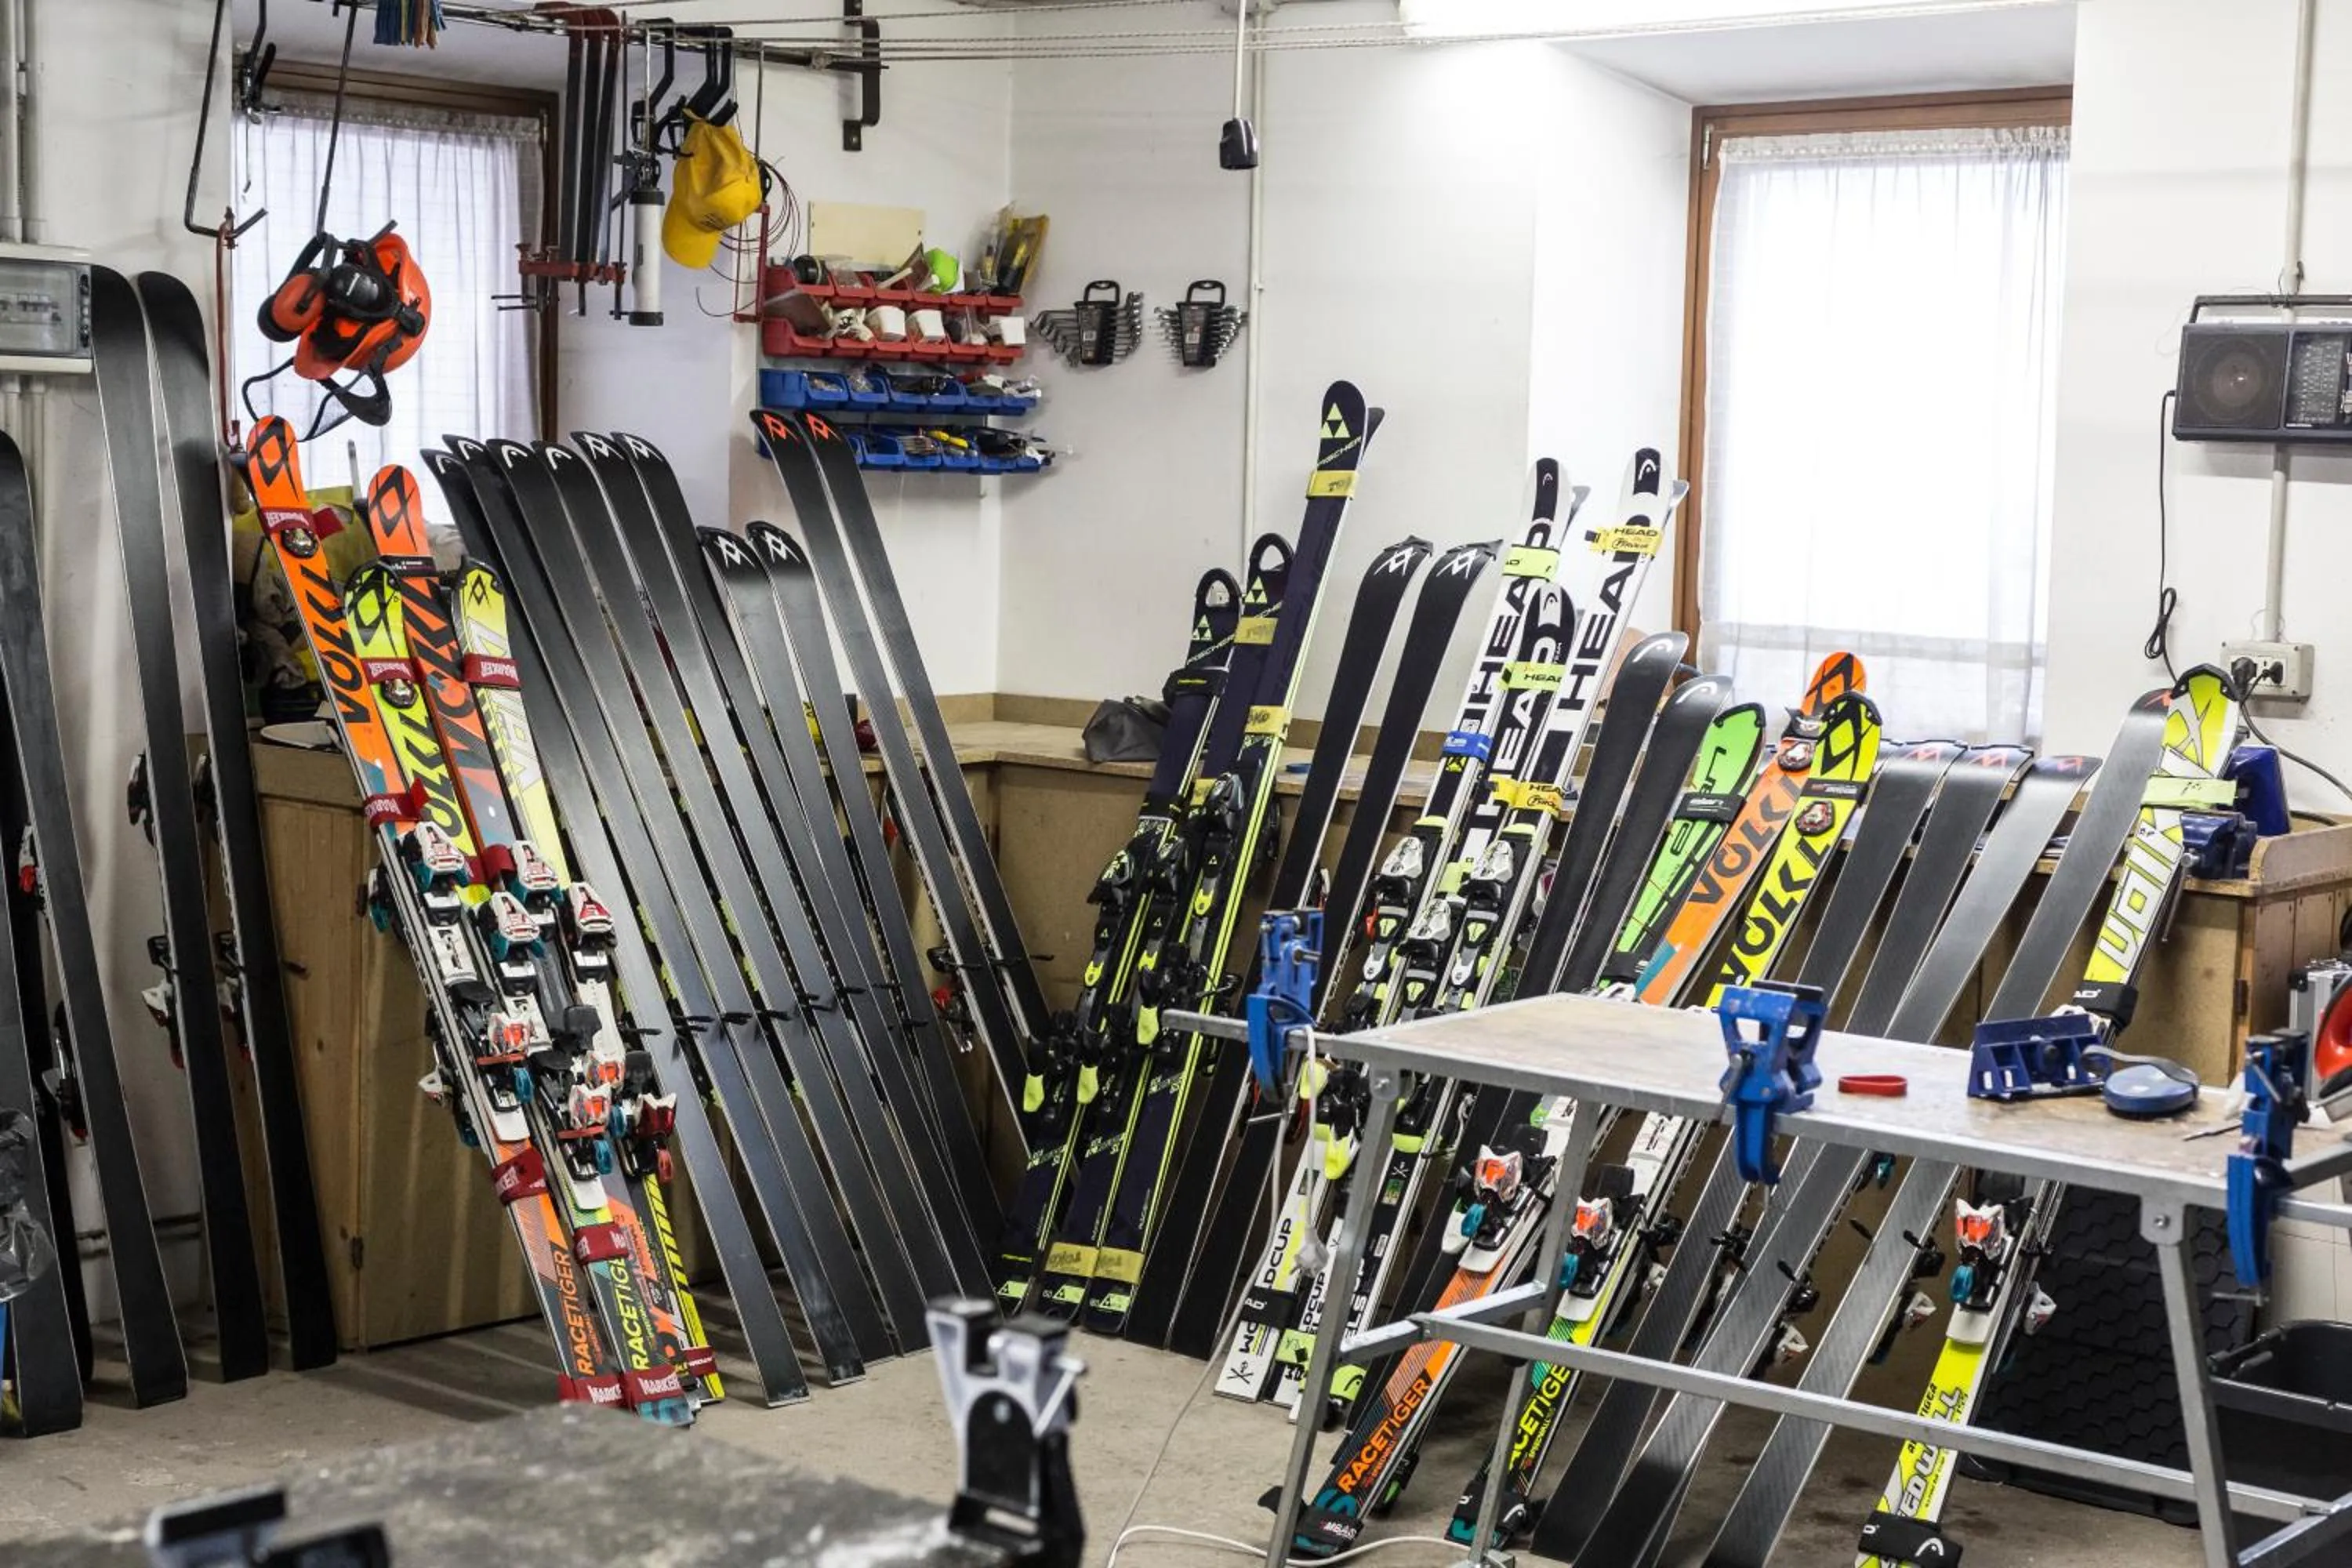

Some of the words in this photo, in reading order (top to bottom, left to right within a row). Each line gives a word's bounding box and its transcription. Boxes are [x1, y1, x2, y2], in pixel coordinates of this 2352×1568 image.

[1613, 527, 1657, 537] HEAD
[1529, 784, 1565, 797] HEA
[554, 1250, 596, 1376] RACETIGER
[609, 1258, 652, 1370] RACETIGE
[1336, 1376, 1432, 1494] RACETIGER
